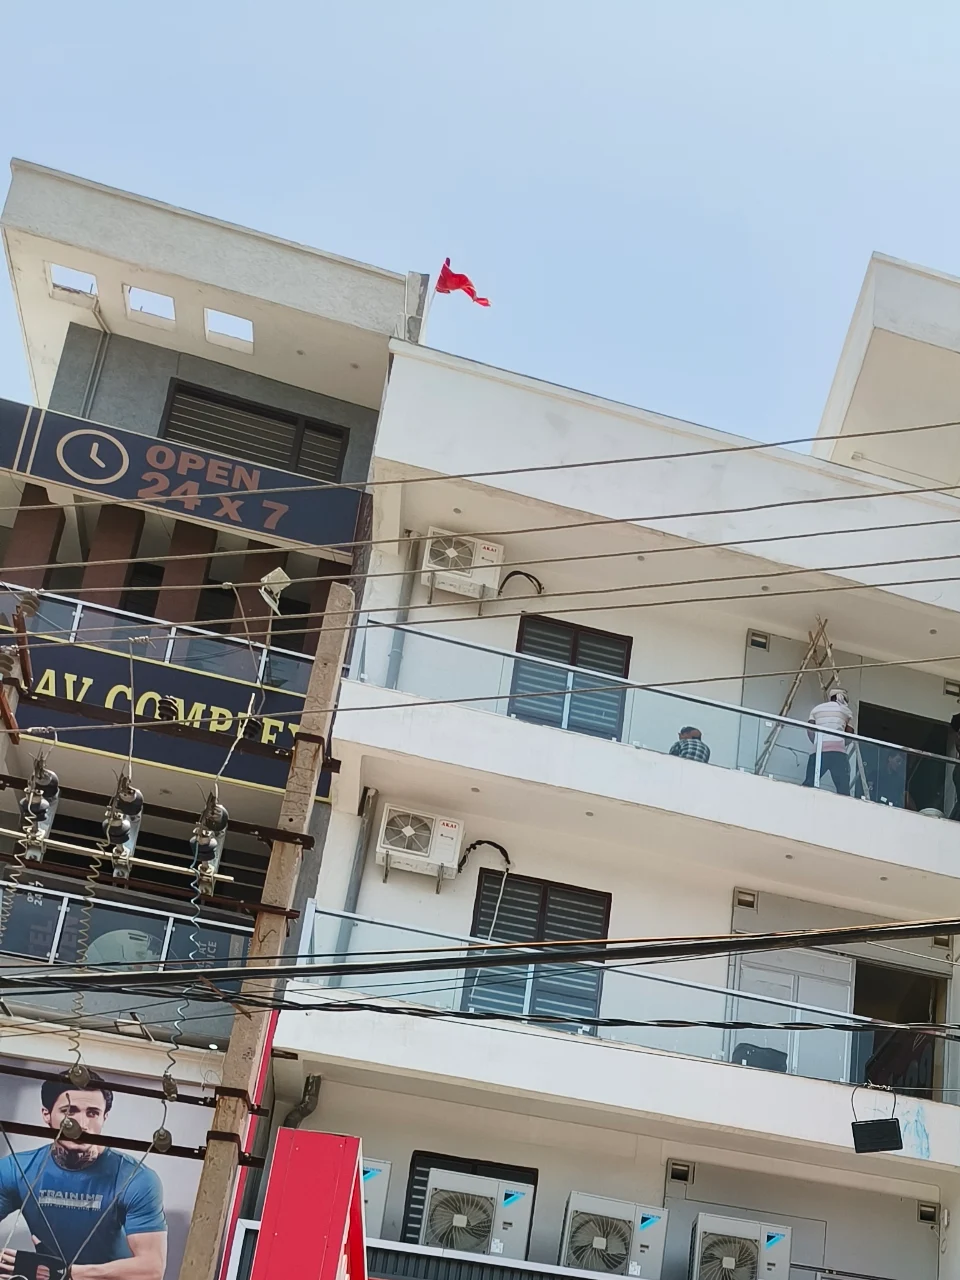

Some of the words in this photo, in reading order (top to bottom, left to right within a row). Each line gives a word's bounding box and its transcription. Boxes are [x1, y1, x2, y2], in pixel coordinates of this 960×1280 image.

[145, 445, 260, 492] OPEN
[137, 472, 201, 511] 24
[261, 501, 290, 531] 7
[21, 668, 94, 703] AV
[104, 684, 299, 745] COMPE
[441, 821, 457, 829] AKAI
